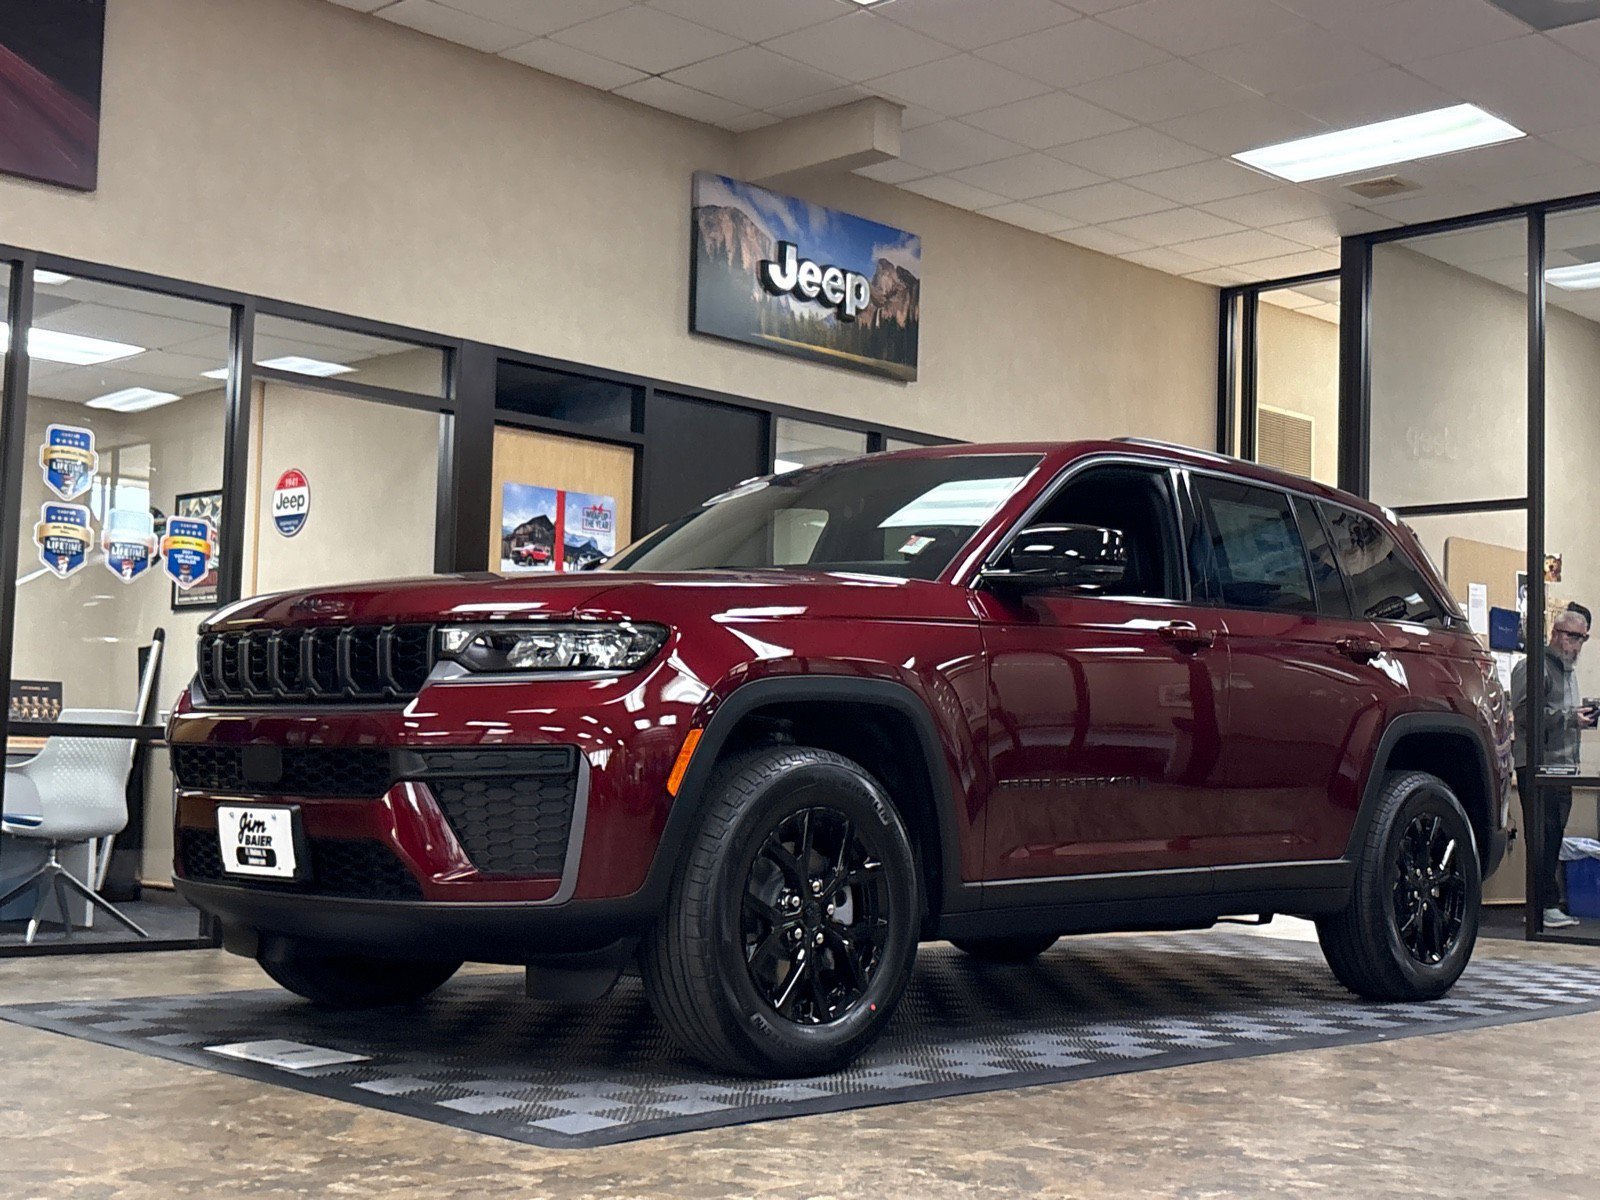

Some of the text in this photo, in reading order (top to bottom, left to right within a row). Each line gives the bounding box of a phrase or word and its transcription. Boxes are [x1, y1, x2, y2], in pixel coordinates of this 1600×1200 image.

[760, 241, 870, 321] Jeep
[276, 492, 305, 511] Jeep
[585, 519, 609, 529] THE YEAR
[46, 540, 82, 552] LIFETIME
[238, 812, 266, 844] Jim
[245, 835, 272, 847] BAIER
